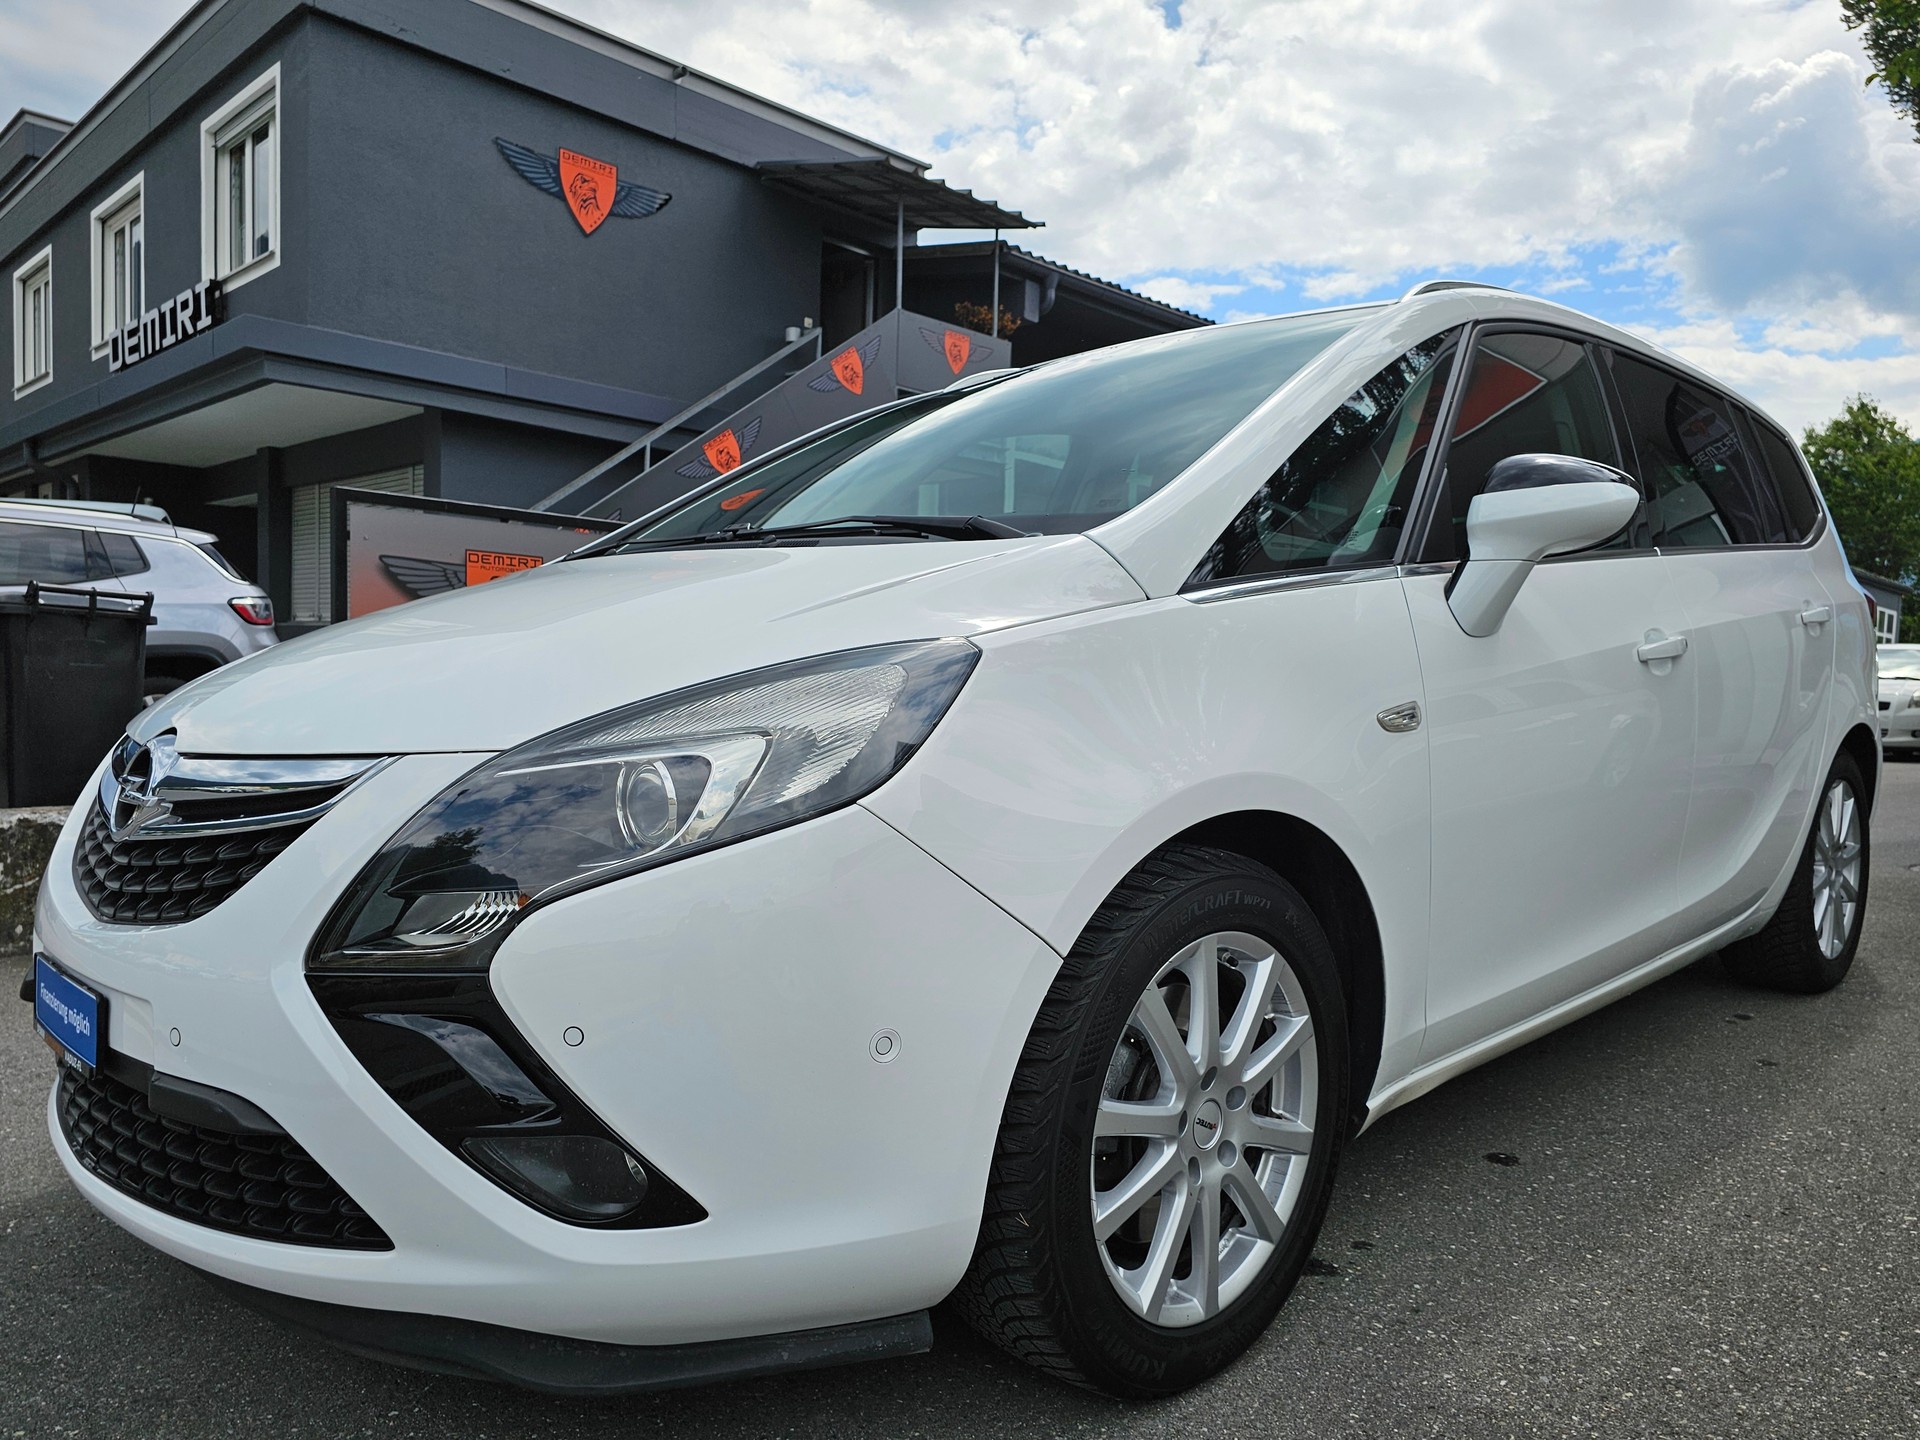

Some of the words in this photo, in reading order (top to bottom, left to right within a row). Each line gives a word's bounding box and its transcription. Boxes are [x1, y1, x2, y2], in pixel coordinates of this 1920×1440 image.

[562, 151, 614, 175] DEMIRI
[109, 279, 212, 373] DEMIRI
[468, 552, 541, 568] DEMIRI
[68, 1008, 91, 1037] möglich
